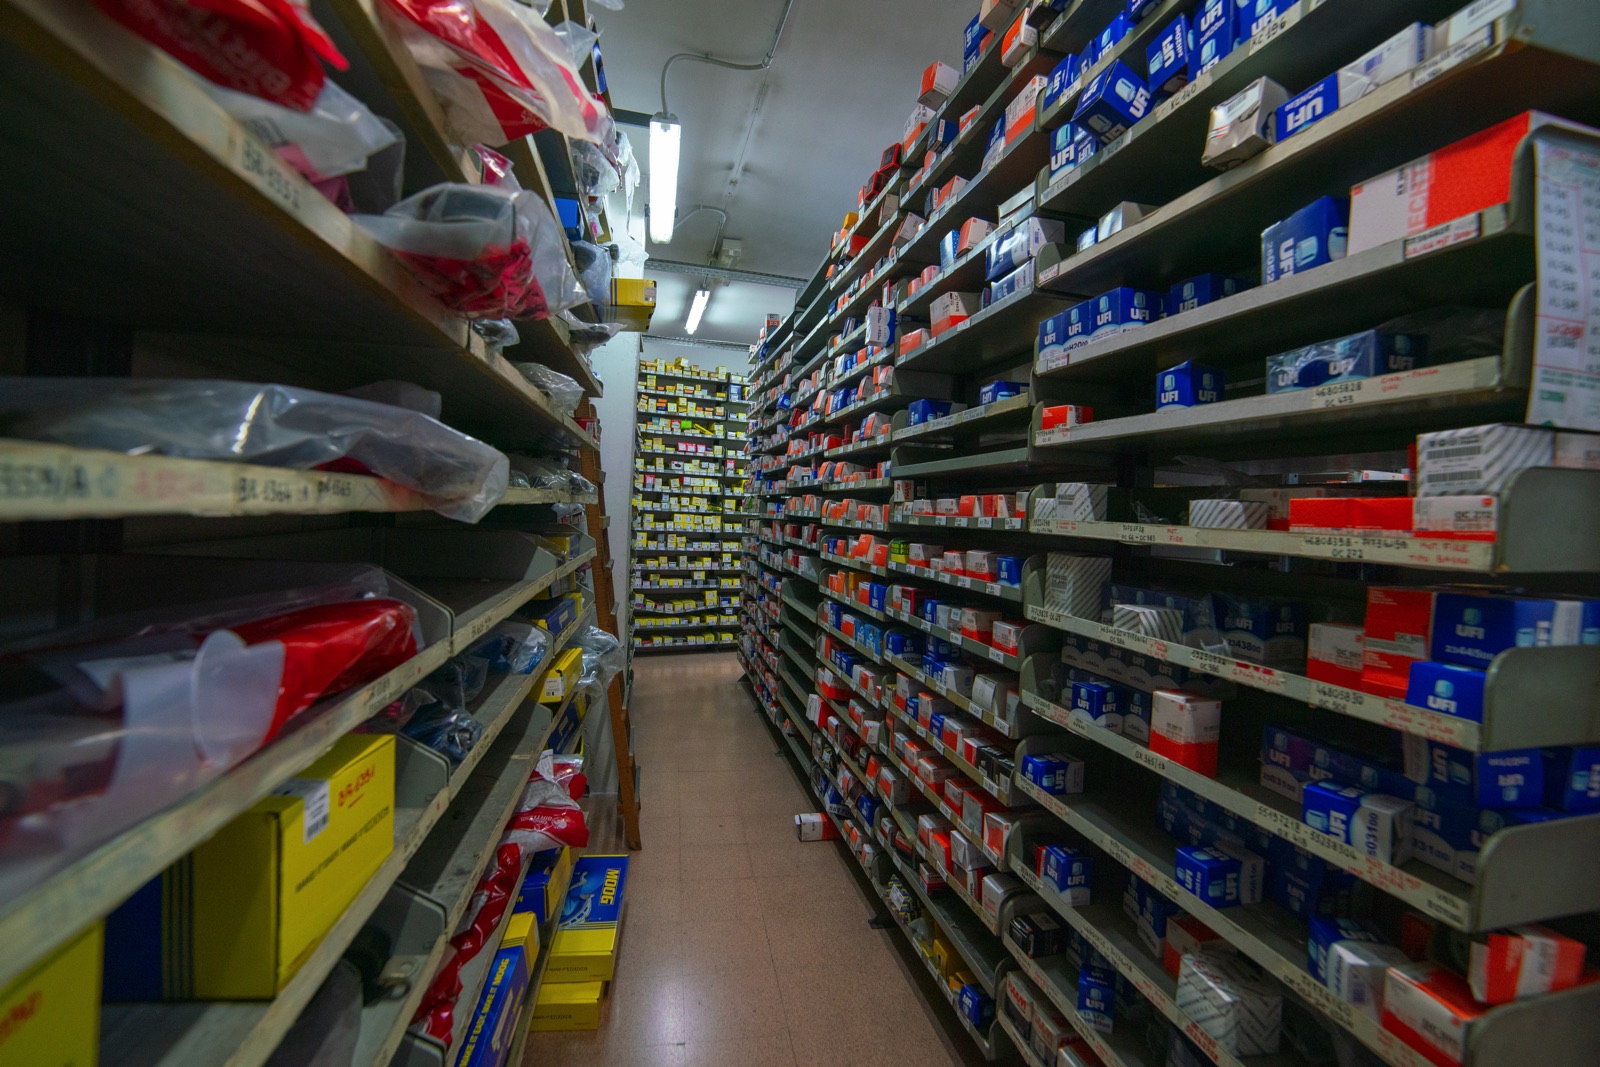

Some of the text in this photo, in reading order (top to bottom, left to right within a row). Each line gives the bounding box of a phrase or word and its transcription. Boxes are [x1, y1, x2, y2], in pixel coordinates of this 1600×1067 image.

[1200, 1, 1223, 32] UFI
[1286, 97, 1324, 132] UFI
[1051, 144, 1075, 171] UFI
[1097, 311, 1112, 326] UFI
[1130, 308, 1149, 321] UFI
[1068, 322, 1082, 336] UFI
[1044, 333, 1056, 345] UFI
[1161, 390, 1178, 404] UFI
[1199, 391, 1217, 402] UFI
[1456, 624, 1485, 640] UFI
[1427, 695, 1458, 713] UFI
[600, 867, 622, 906] MOOG
[1068, 875, 1086, 887] UFI
[493, 958, 510, 986] MOOG
[1086, 997, 1105, 1011] UFI
